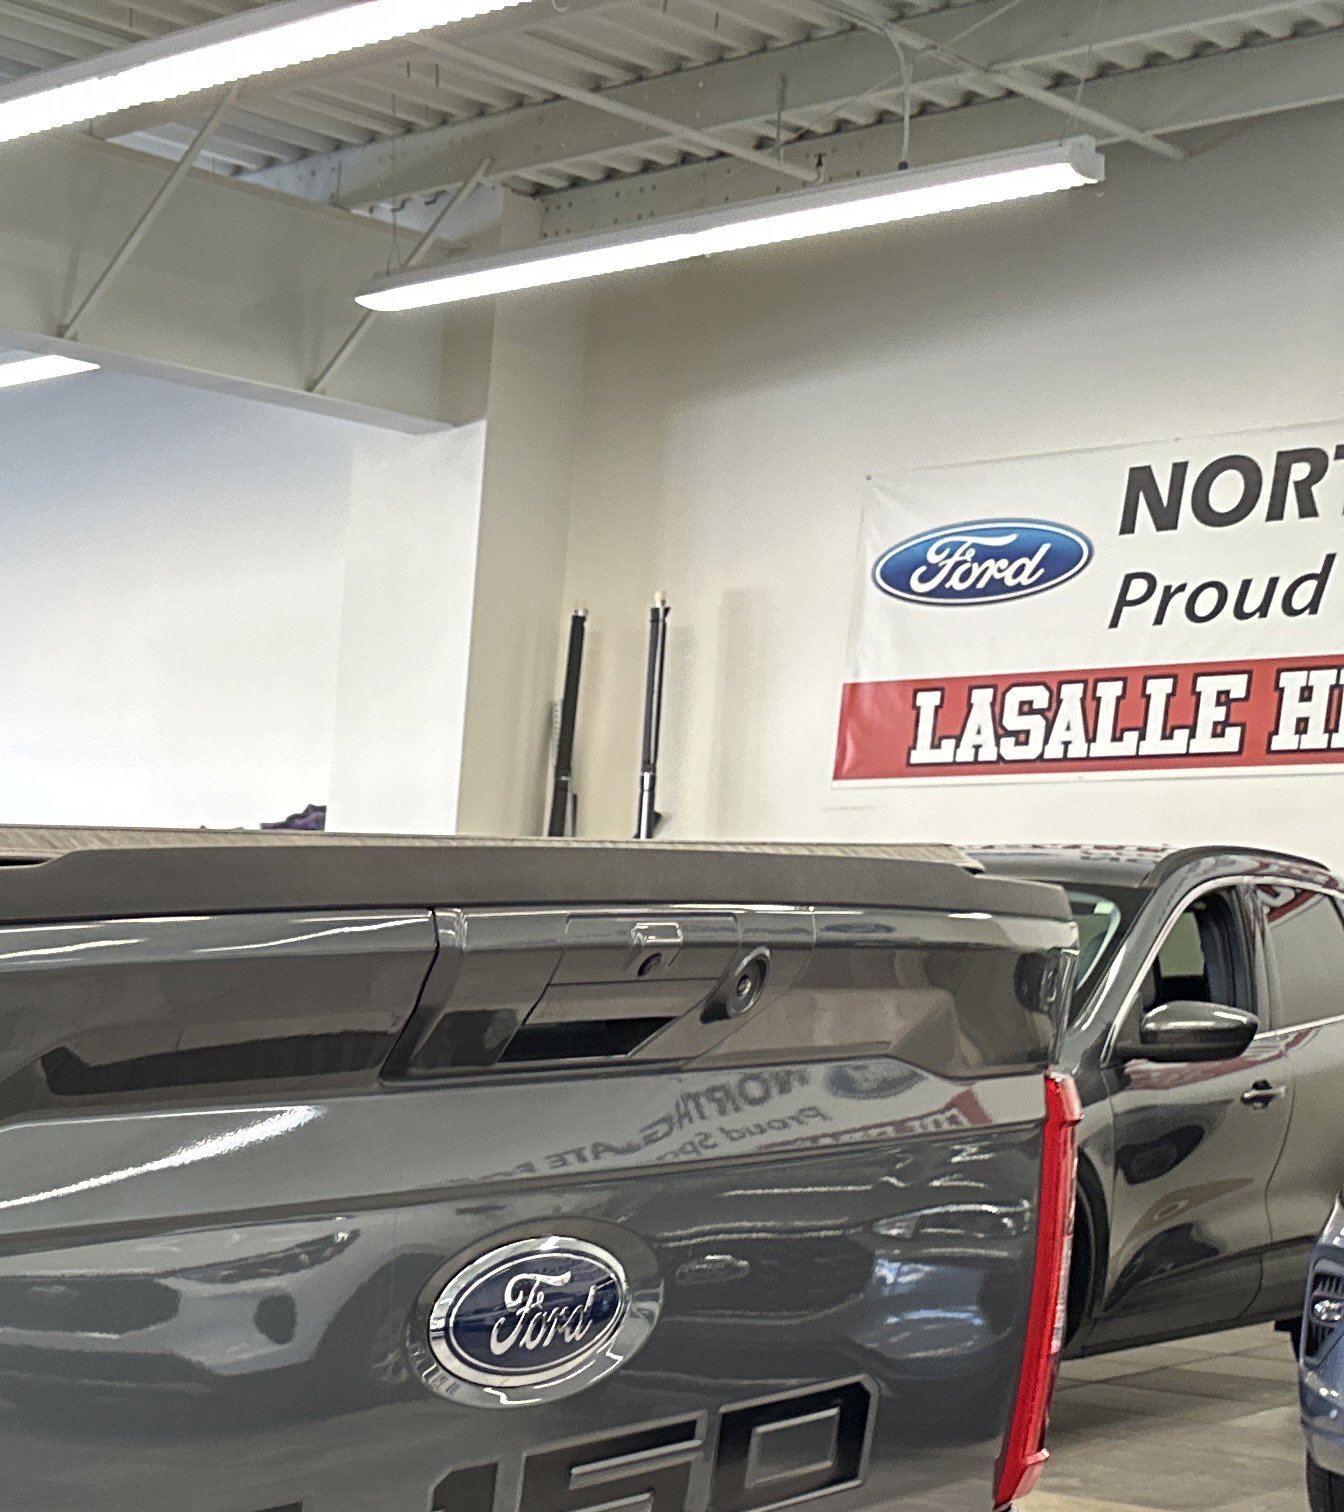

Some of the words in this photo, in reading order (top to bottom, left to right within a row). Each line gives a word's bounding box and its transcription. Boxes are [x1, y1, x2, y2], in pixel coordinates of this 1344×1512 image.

[1119, 445, 1344, 536] NOR
[910, 533, 1046, 593] Ford
[1109, 553, 1337, 629] Proud
[907, 670, 1251, 768] LASALLE
[1267, 665, 1344, 756] H
[489, 1271, 603, 1357] Ford
